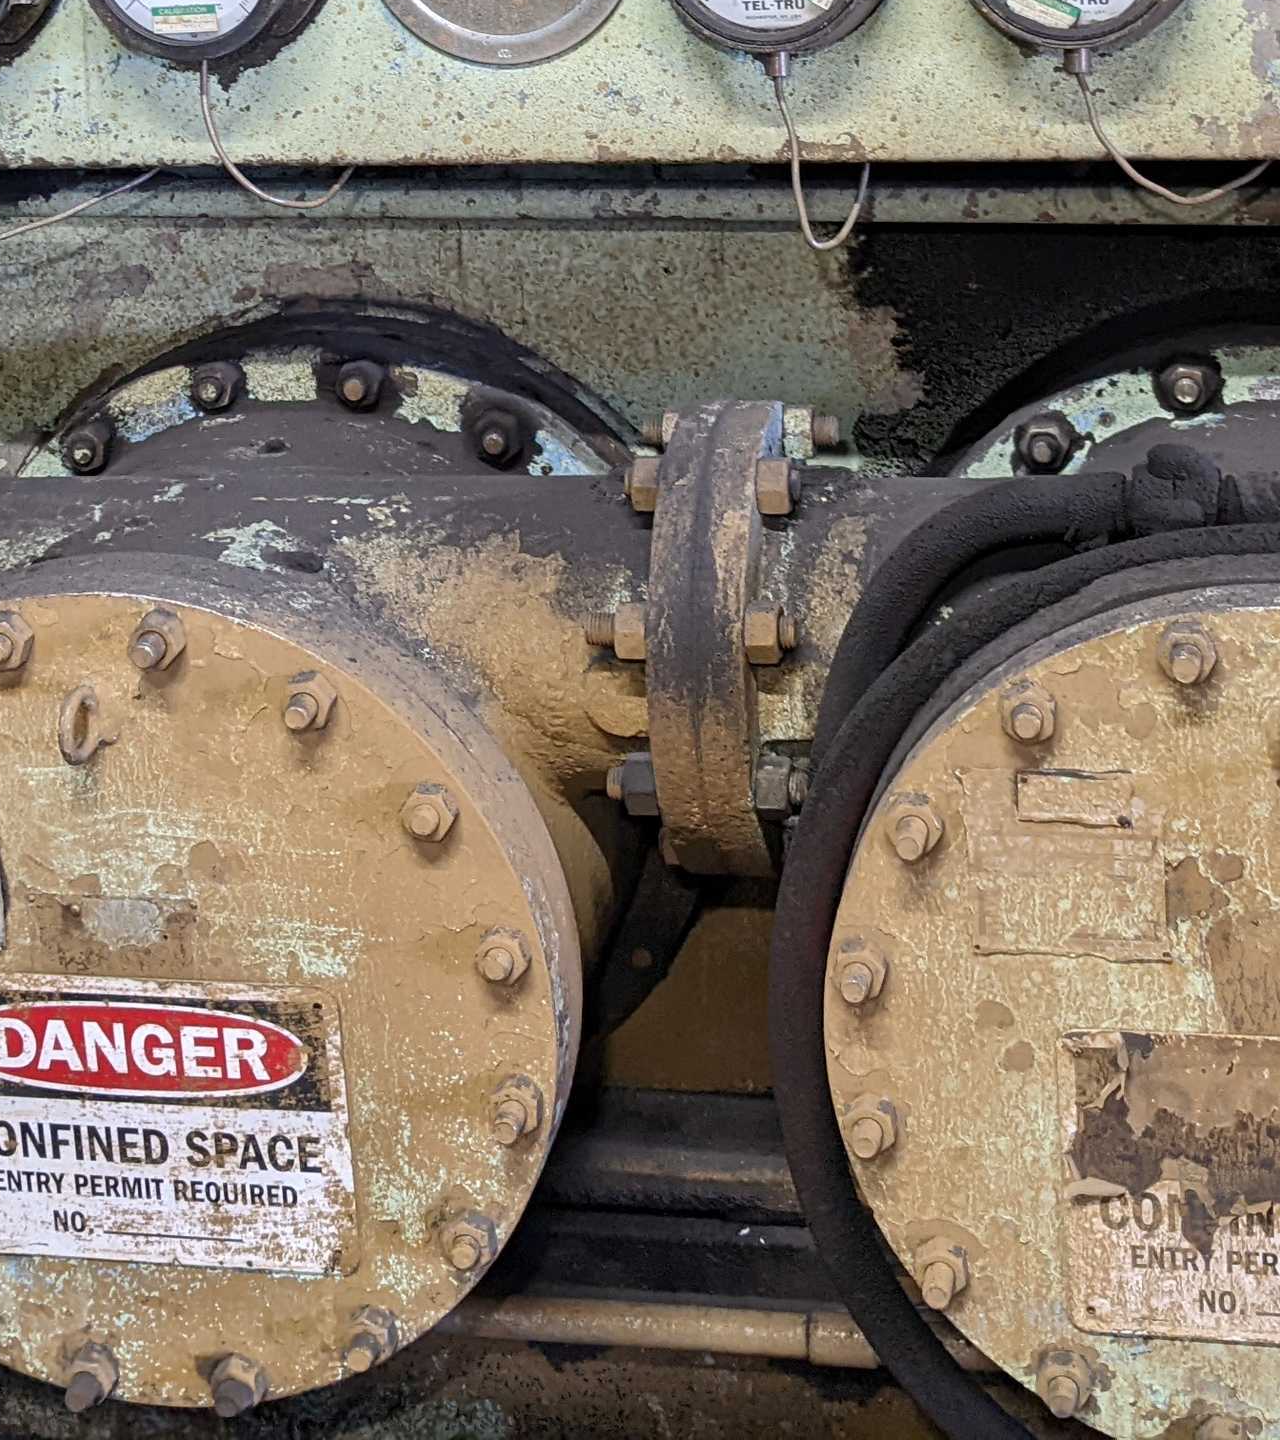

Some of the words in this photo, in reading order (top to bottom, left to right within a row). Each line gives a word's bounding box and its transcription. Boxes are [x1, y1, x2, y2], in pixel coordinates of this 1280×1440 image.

[742, 0, 805, 11] TEL-TRU
[186, 1128, 321, 1174] SPACE
[74, 1174, 165, 1200] PERMIT
[174, 1180, 298, 1208] REQUIRED
[53, 1210, 95, 1234] NO.
[1131, 1245, 1216, 1275] ENTRY
